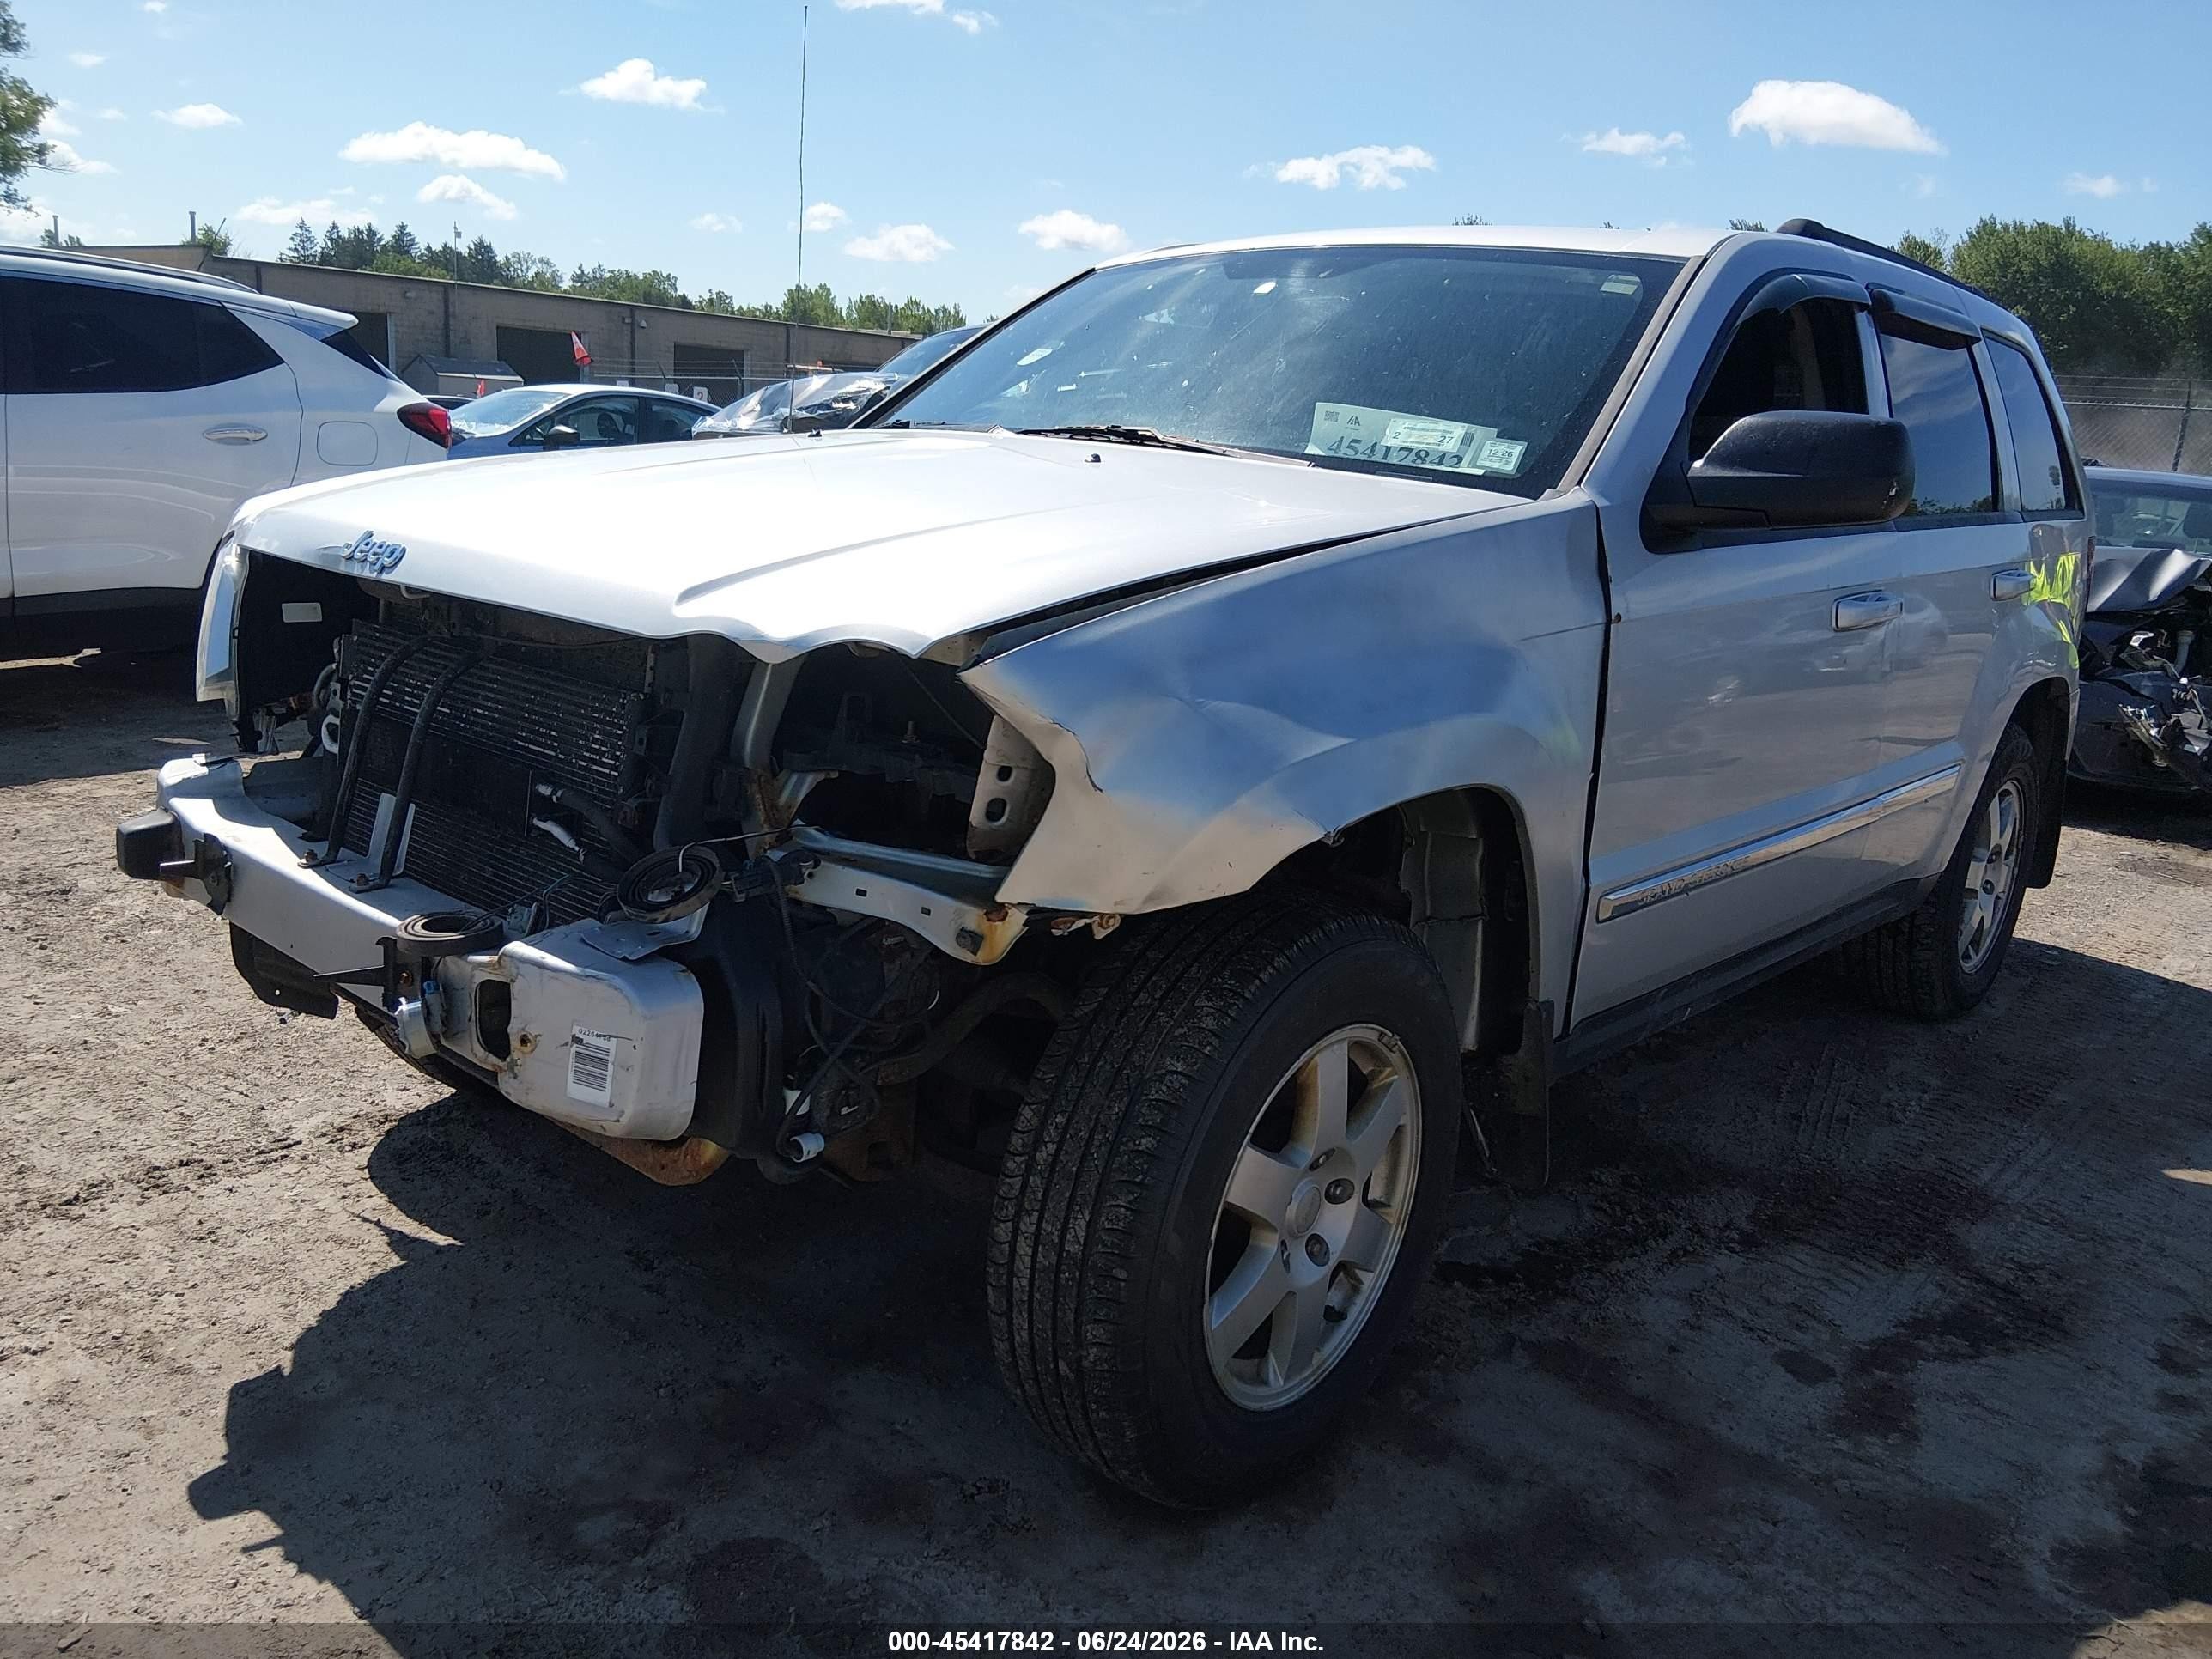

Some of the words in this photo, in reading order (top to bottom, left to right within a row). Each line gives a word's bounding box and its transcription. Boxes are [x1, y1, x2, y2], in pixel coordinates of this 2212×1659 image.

[1392, 431, 1401, 440] 2
[1437, 434, 1455, 444] 27
[1327, 435, 1464, 468] 45417842
[1501, 449, 1514, 458] 26
[341, 530, 407, 574] Jeep
